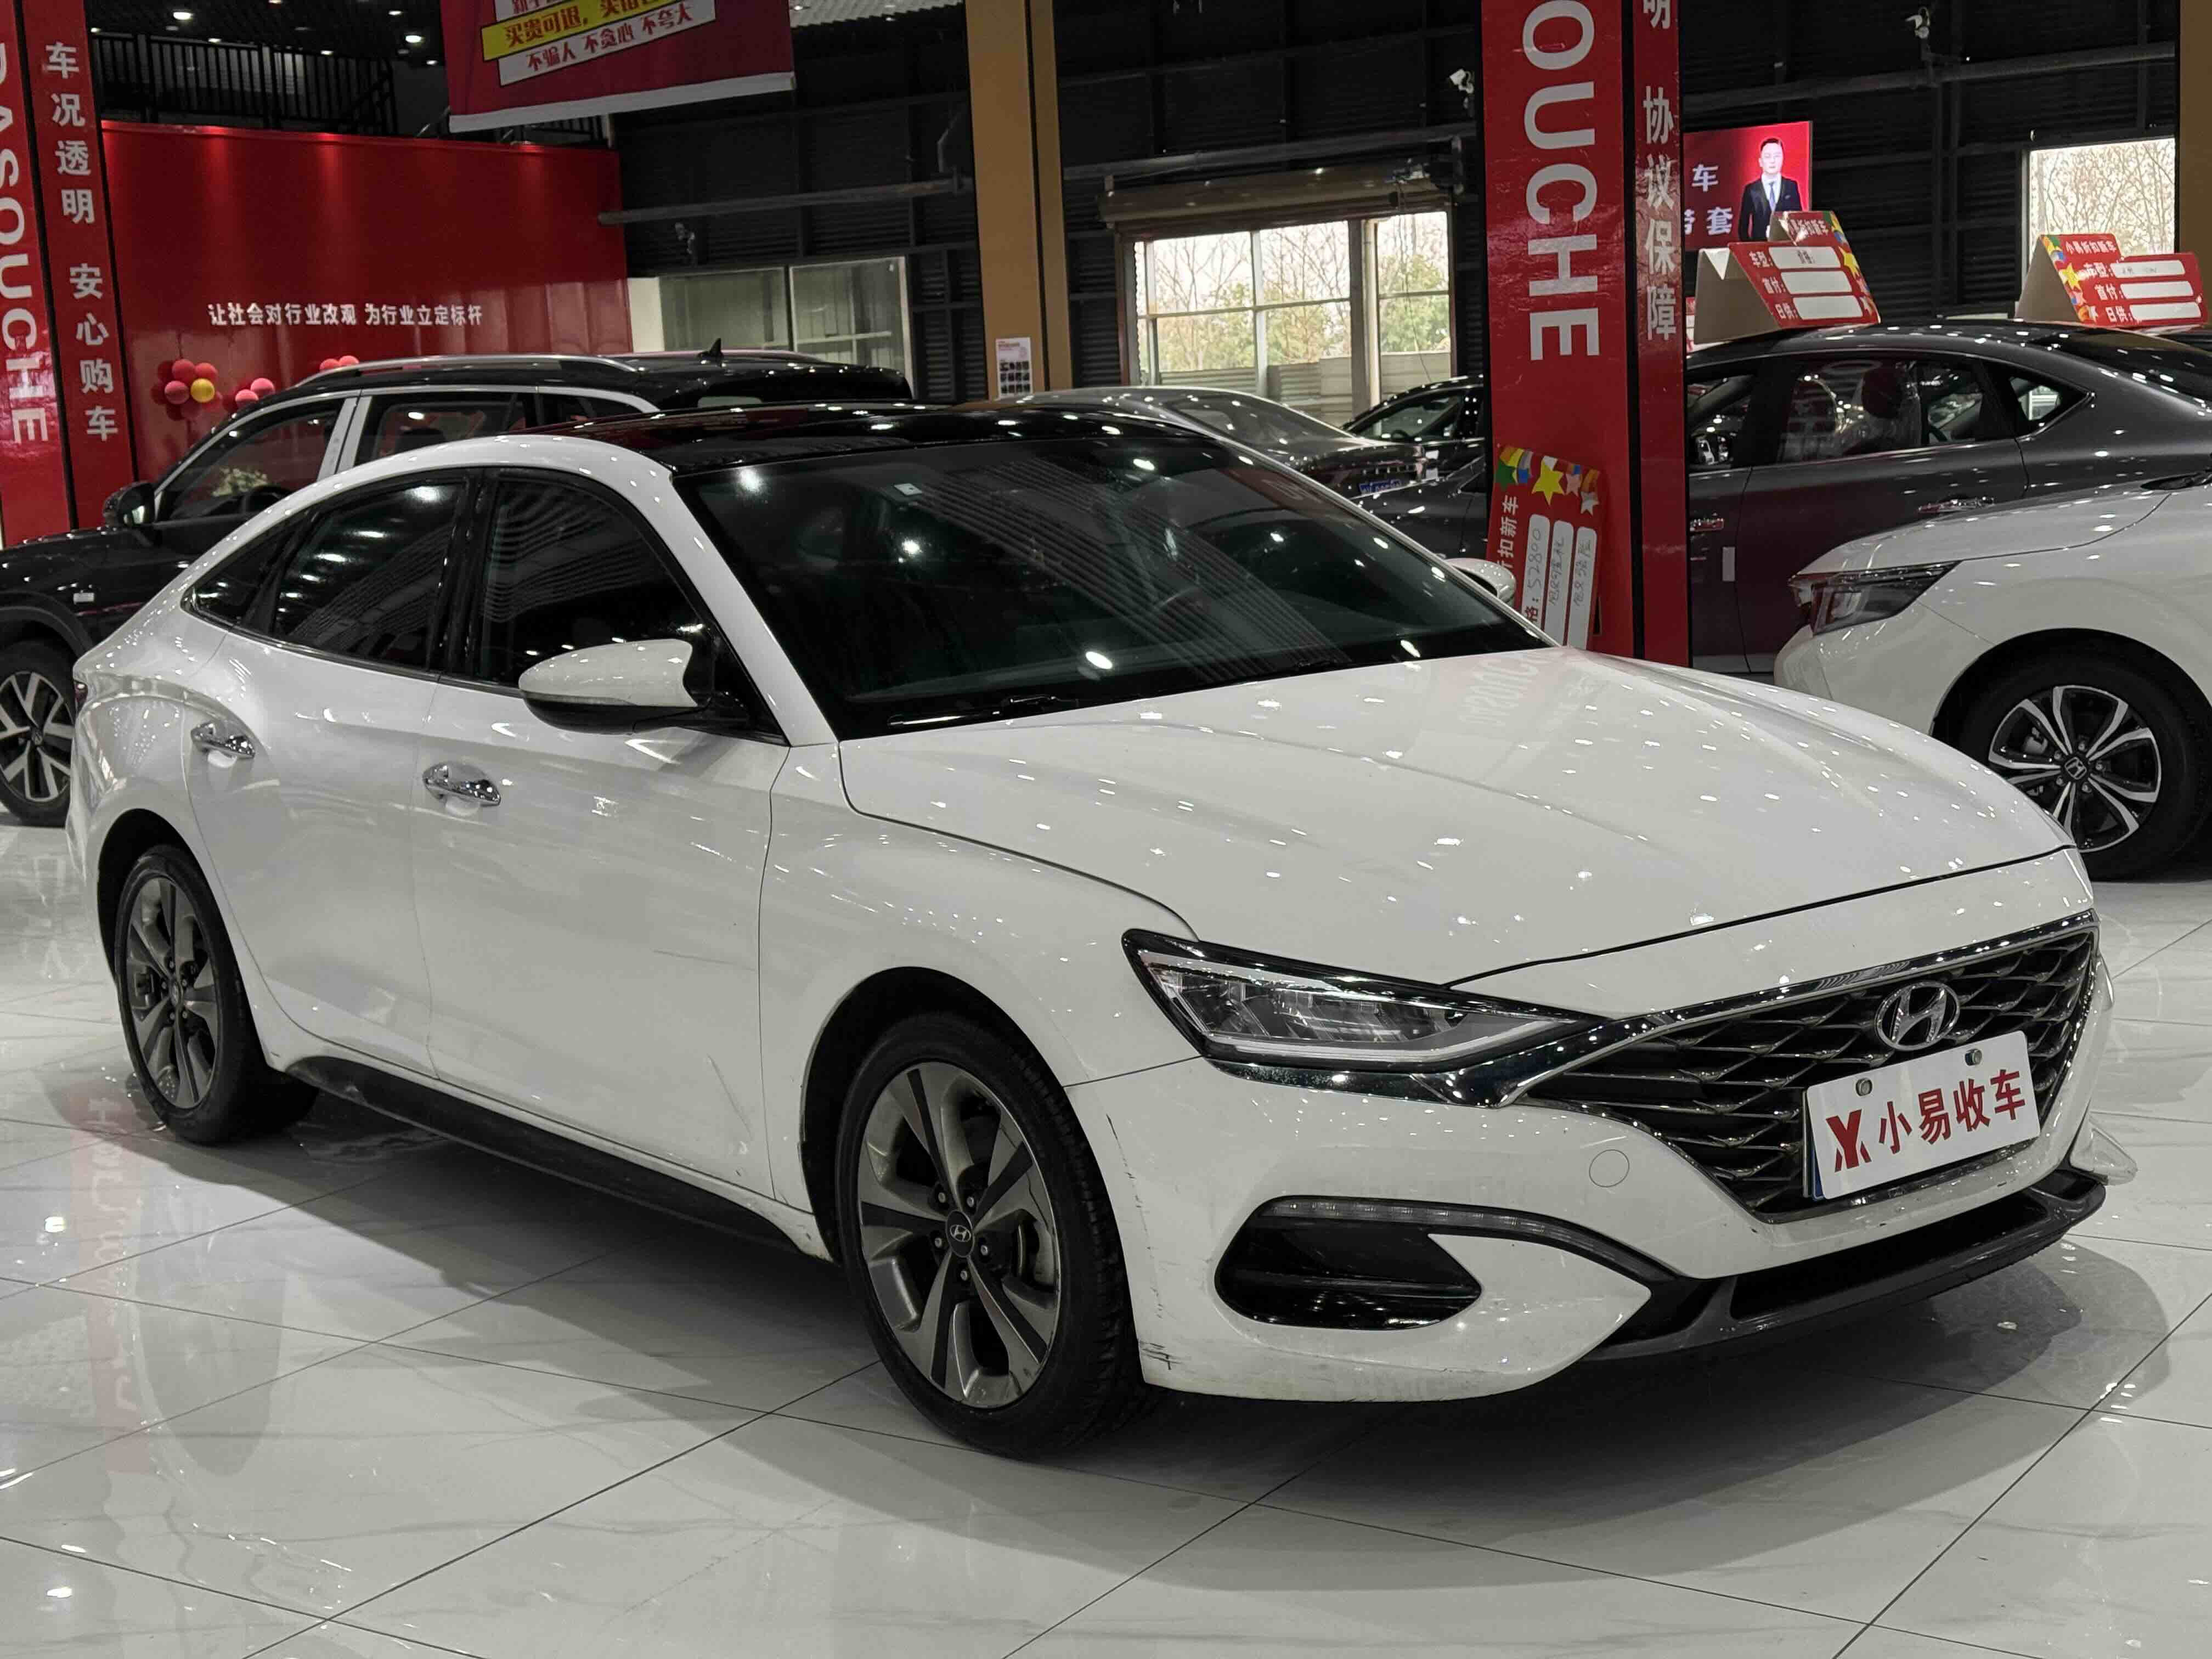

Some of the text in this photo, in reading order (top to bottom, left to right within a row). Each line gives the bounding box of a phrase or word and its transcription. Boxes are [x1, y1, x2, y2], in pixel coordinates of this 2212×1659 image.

[641, 2, 693, 36] 不夸大
[1522, 0, 1600, 360] OUCHE
[1691, 163, 1718, 192] 车
[46, 42, 119, 441] 车况透明 安心购车
[208, 302, 483, 326] 让社会对行业改观 为行业立定标杆
[1878, 1069, 2026, 1155] 小易收车
